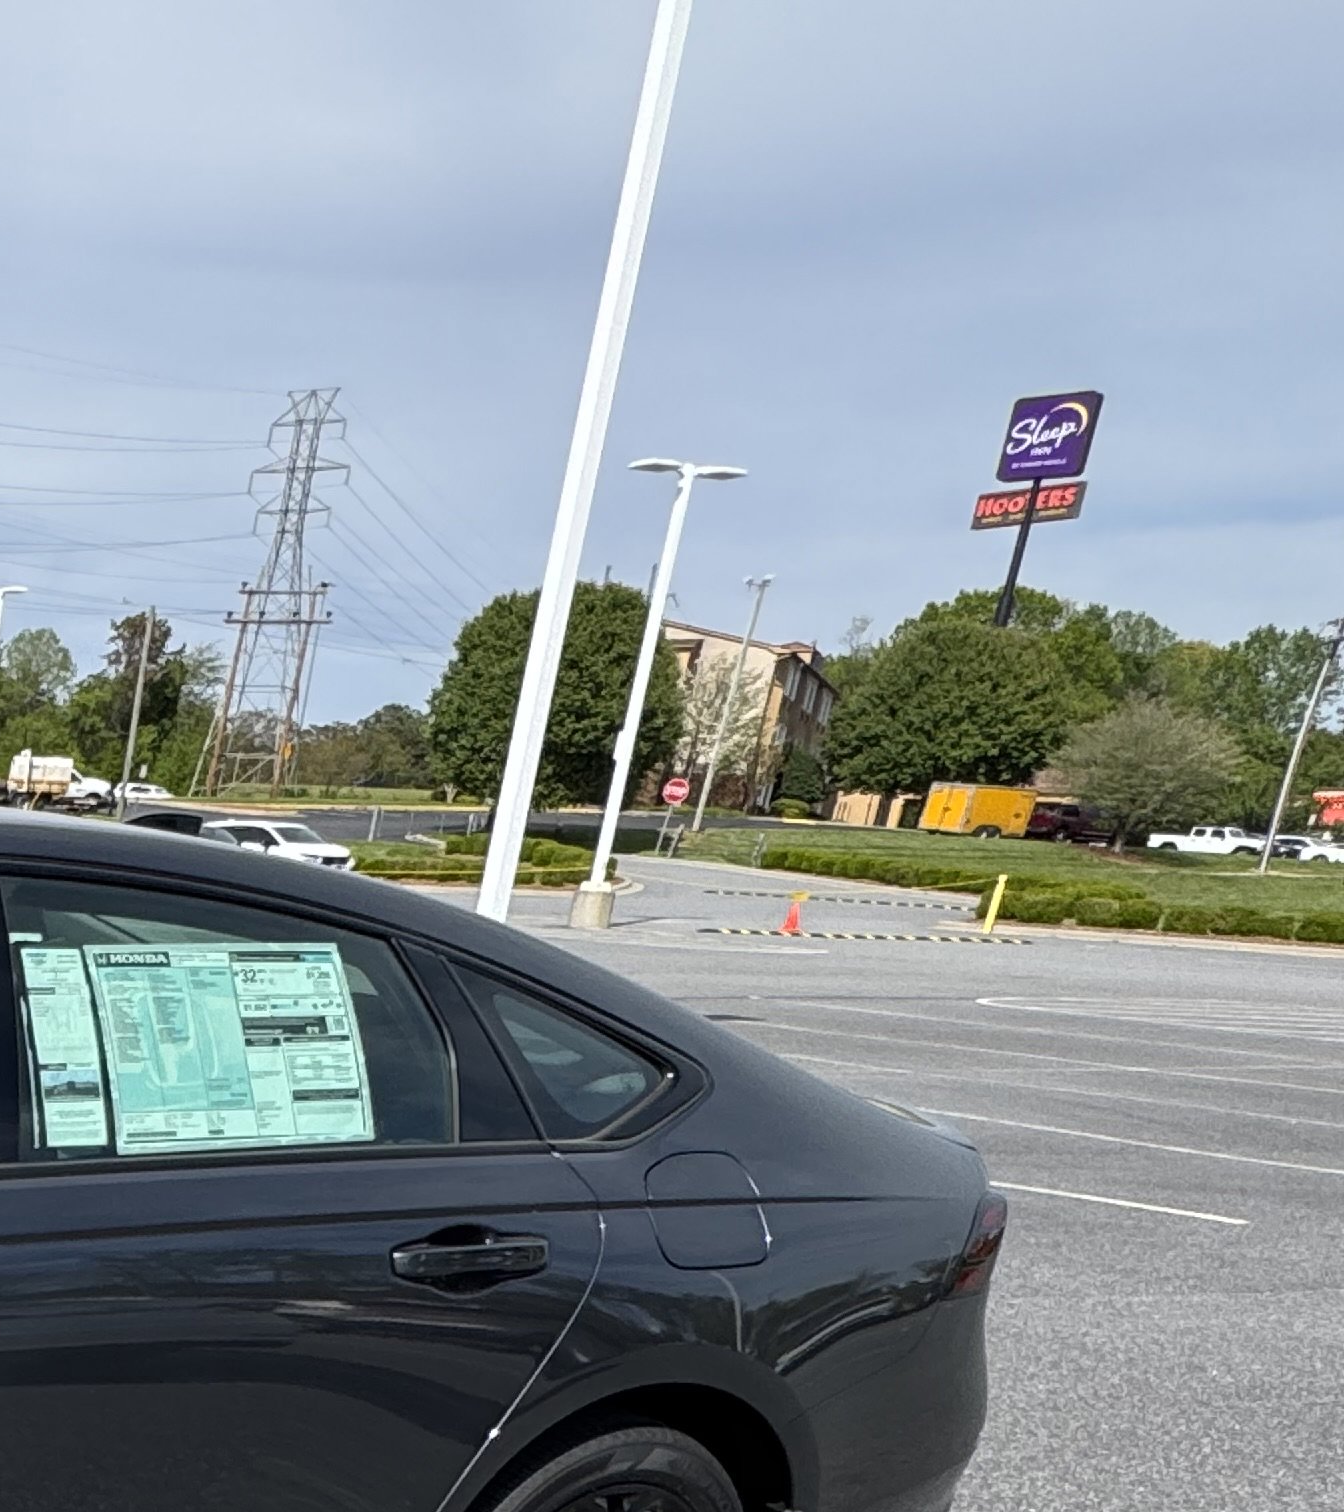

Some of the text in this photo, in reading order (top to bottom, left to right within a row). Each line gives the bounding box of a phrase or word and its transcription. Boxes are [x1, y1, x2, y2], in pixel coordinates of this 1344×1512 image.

[1007, 415, 1077, 455] Sleep
[109, 953, 168, 965] HONDA
[240, 968, 258, 984] 32
